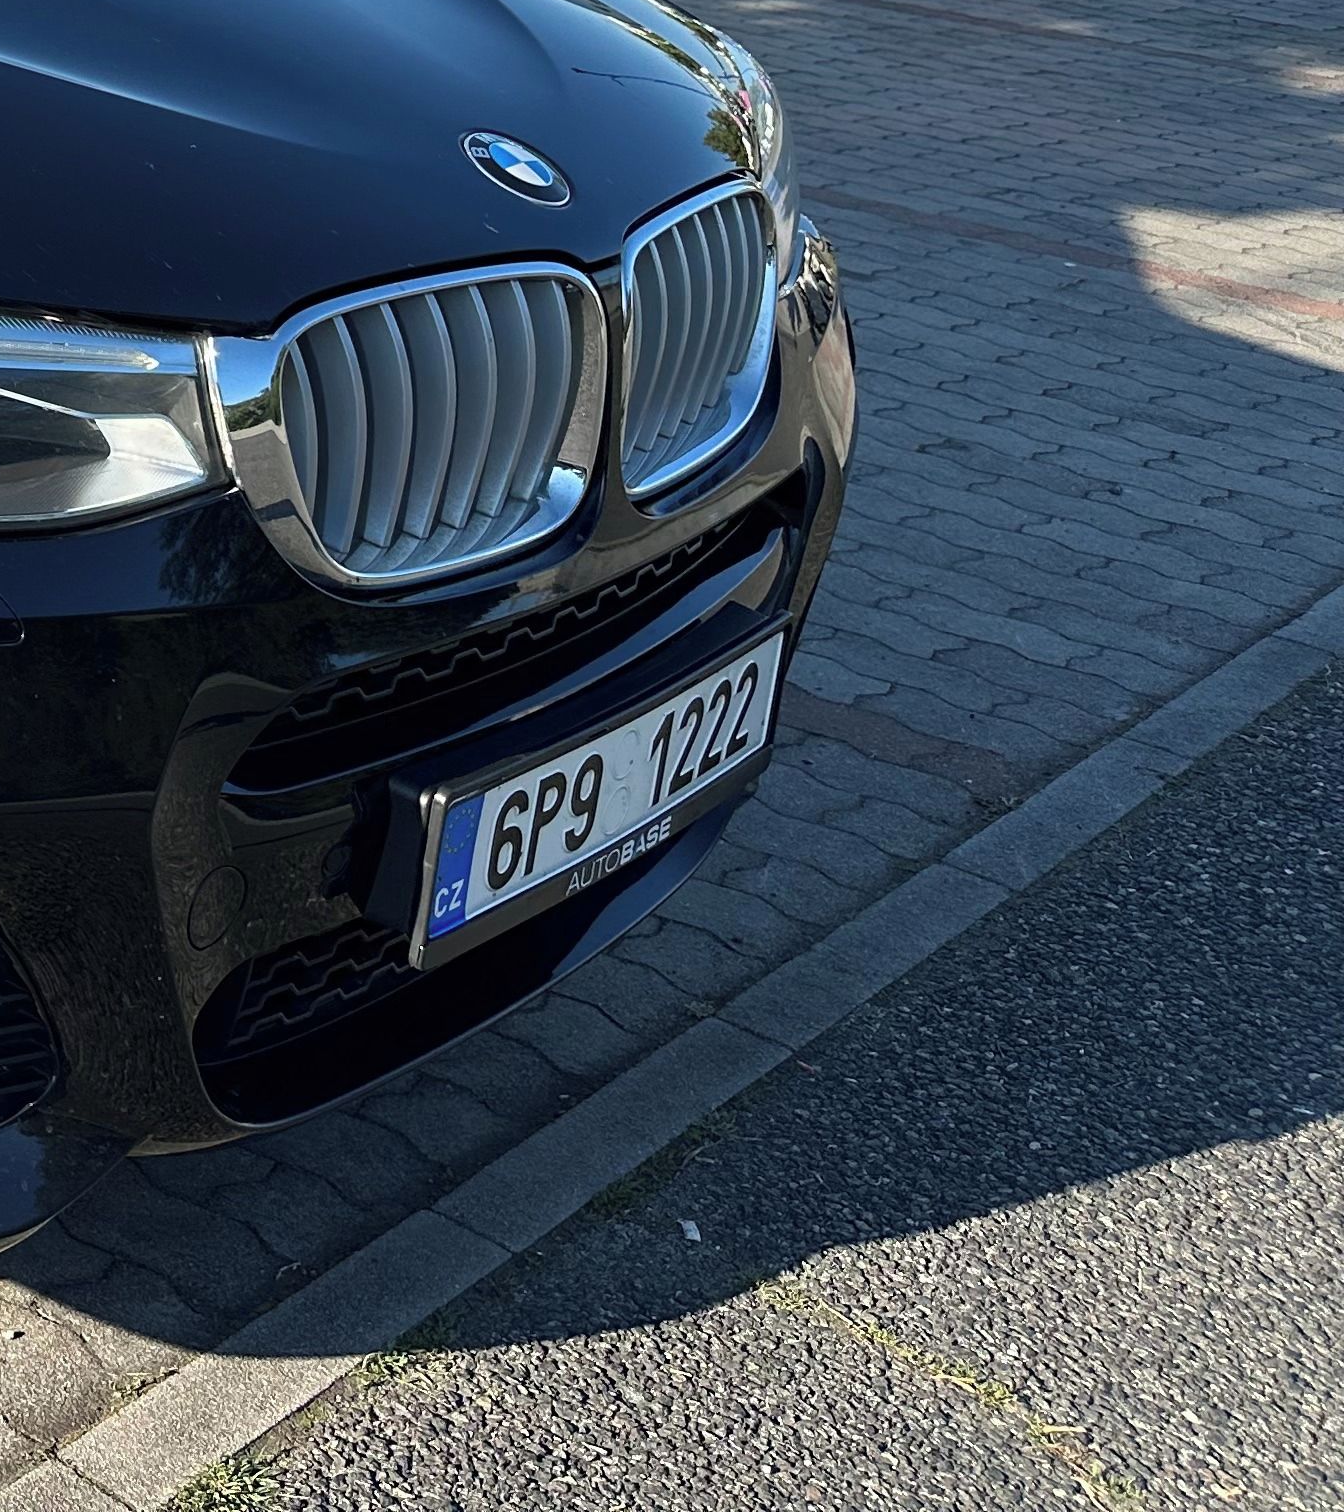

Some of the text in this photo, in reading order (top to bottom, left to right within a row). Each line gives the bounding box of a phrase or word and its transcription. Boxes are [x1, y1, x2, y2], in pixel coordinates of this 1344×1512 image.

[486, 661, 760, 891] 6P9 1222
[565, 815, 673, 897] AUTOBASE
[434, 878, 465, 919] CZ
